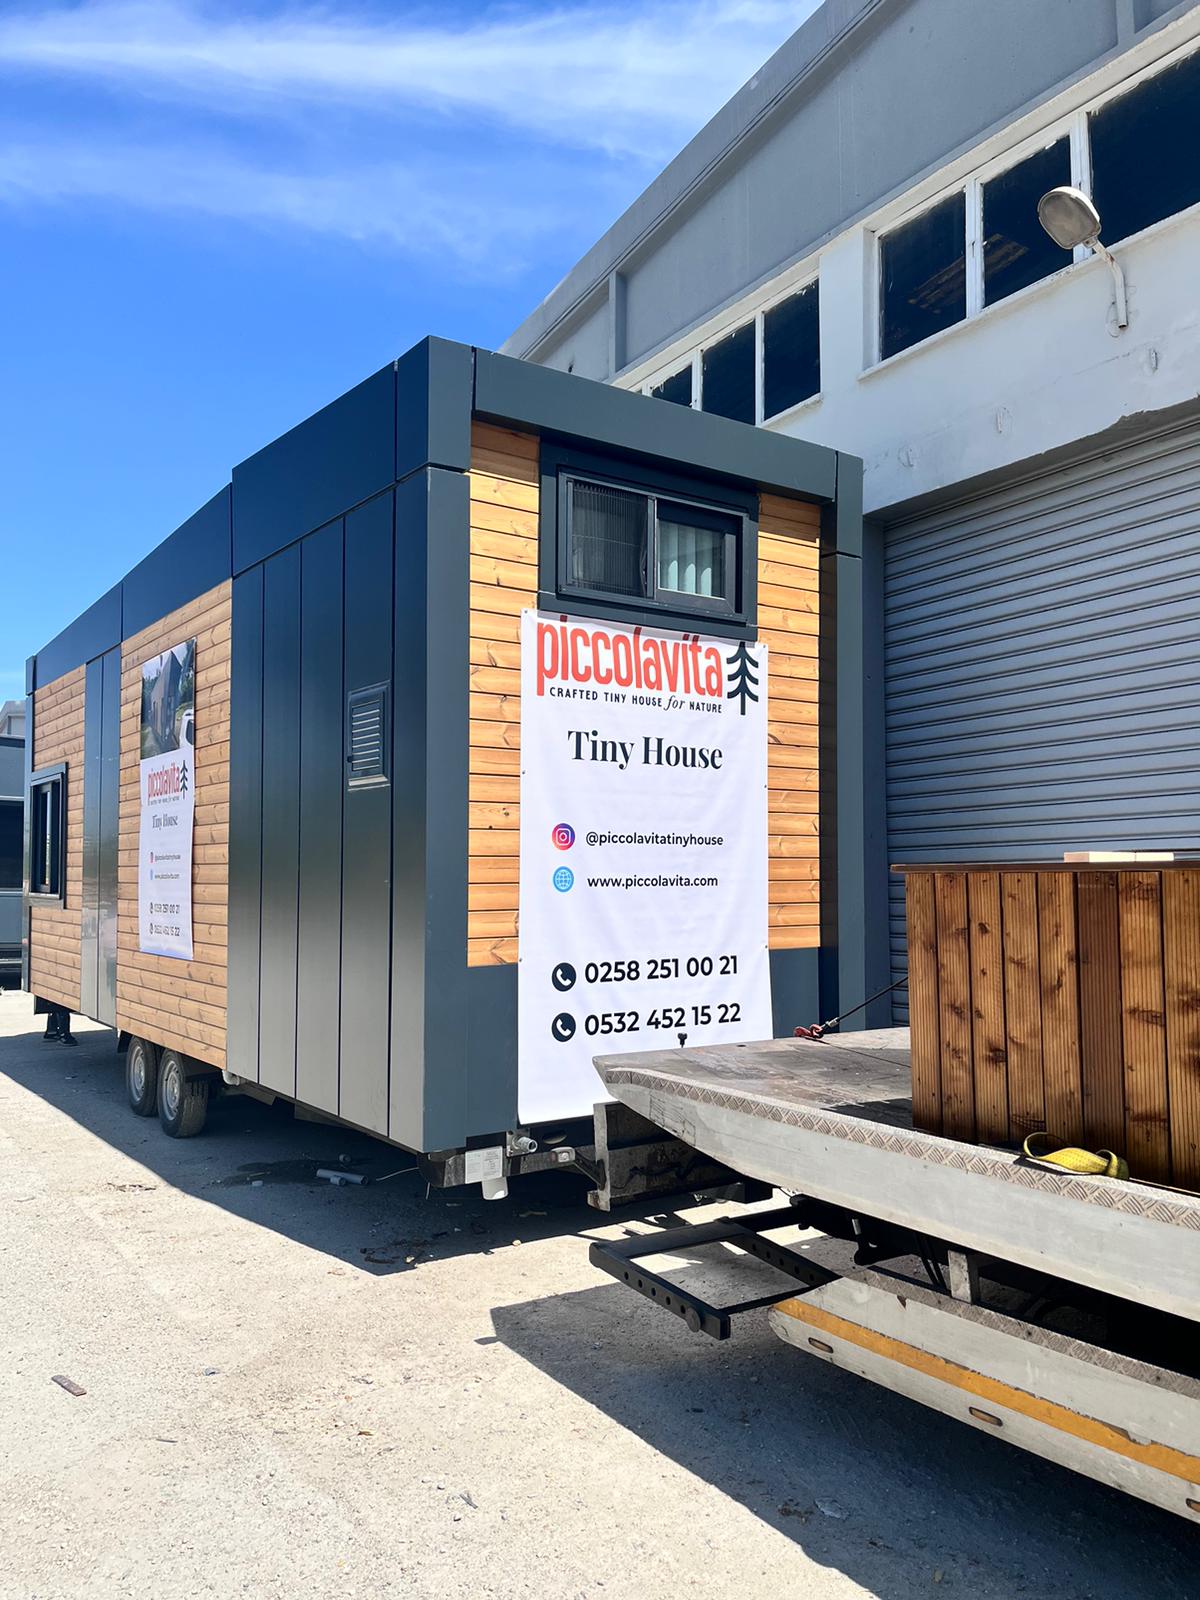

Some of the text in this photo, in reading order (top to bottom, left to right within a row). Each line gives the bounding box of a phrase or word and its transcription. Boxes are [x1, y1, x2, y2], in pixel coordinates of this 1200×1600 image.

[537, 614, 723, 698] piccolavita
[549, 686, 722, 713] CRAFTED TINY HOUSE for NATURE
[567, 730, 723, 770] Tiny House
[585, 831, 724, 847] @piccolavitatinyhouse
[587, 874, 719, 890] www.piccolavita.com
[585, 955, 738, 984] 0258 251 00 21
[584, 1003, 741, 1036] 0532 452 15 22
